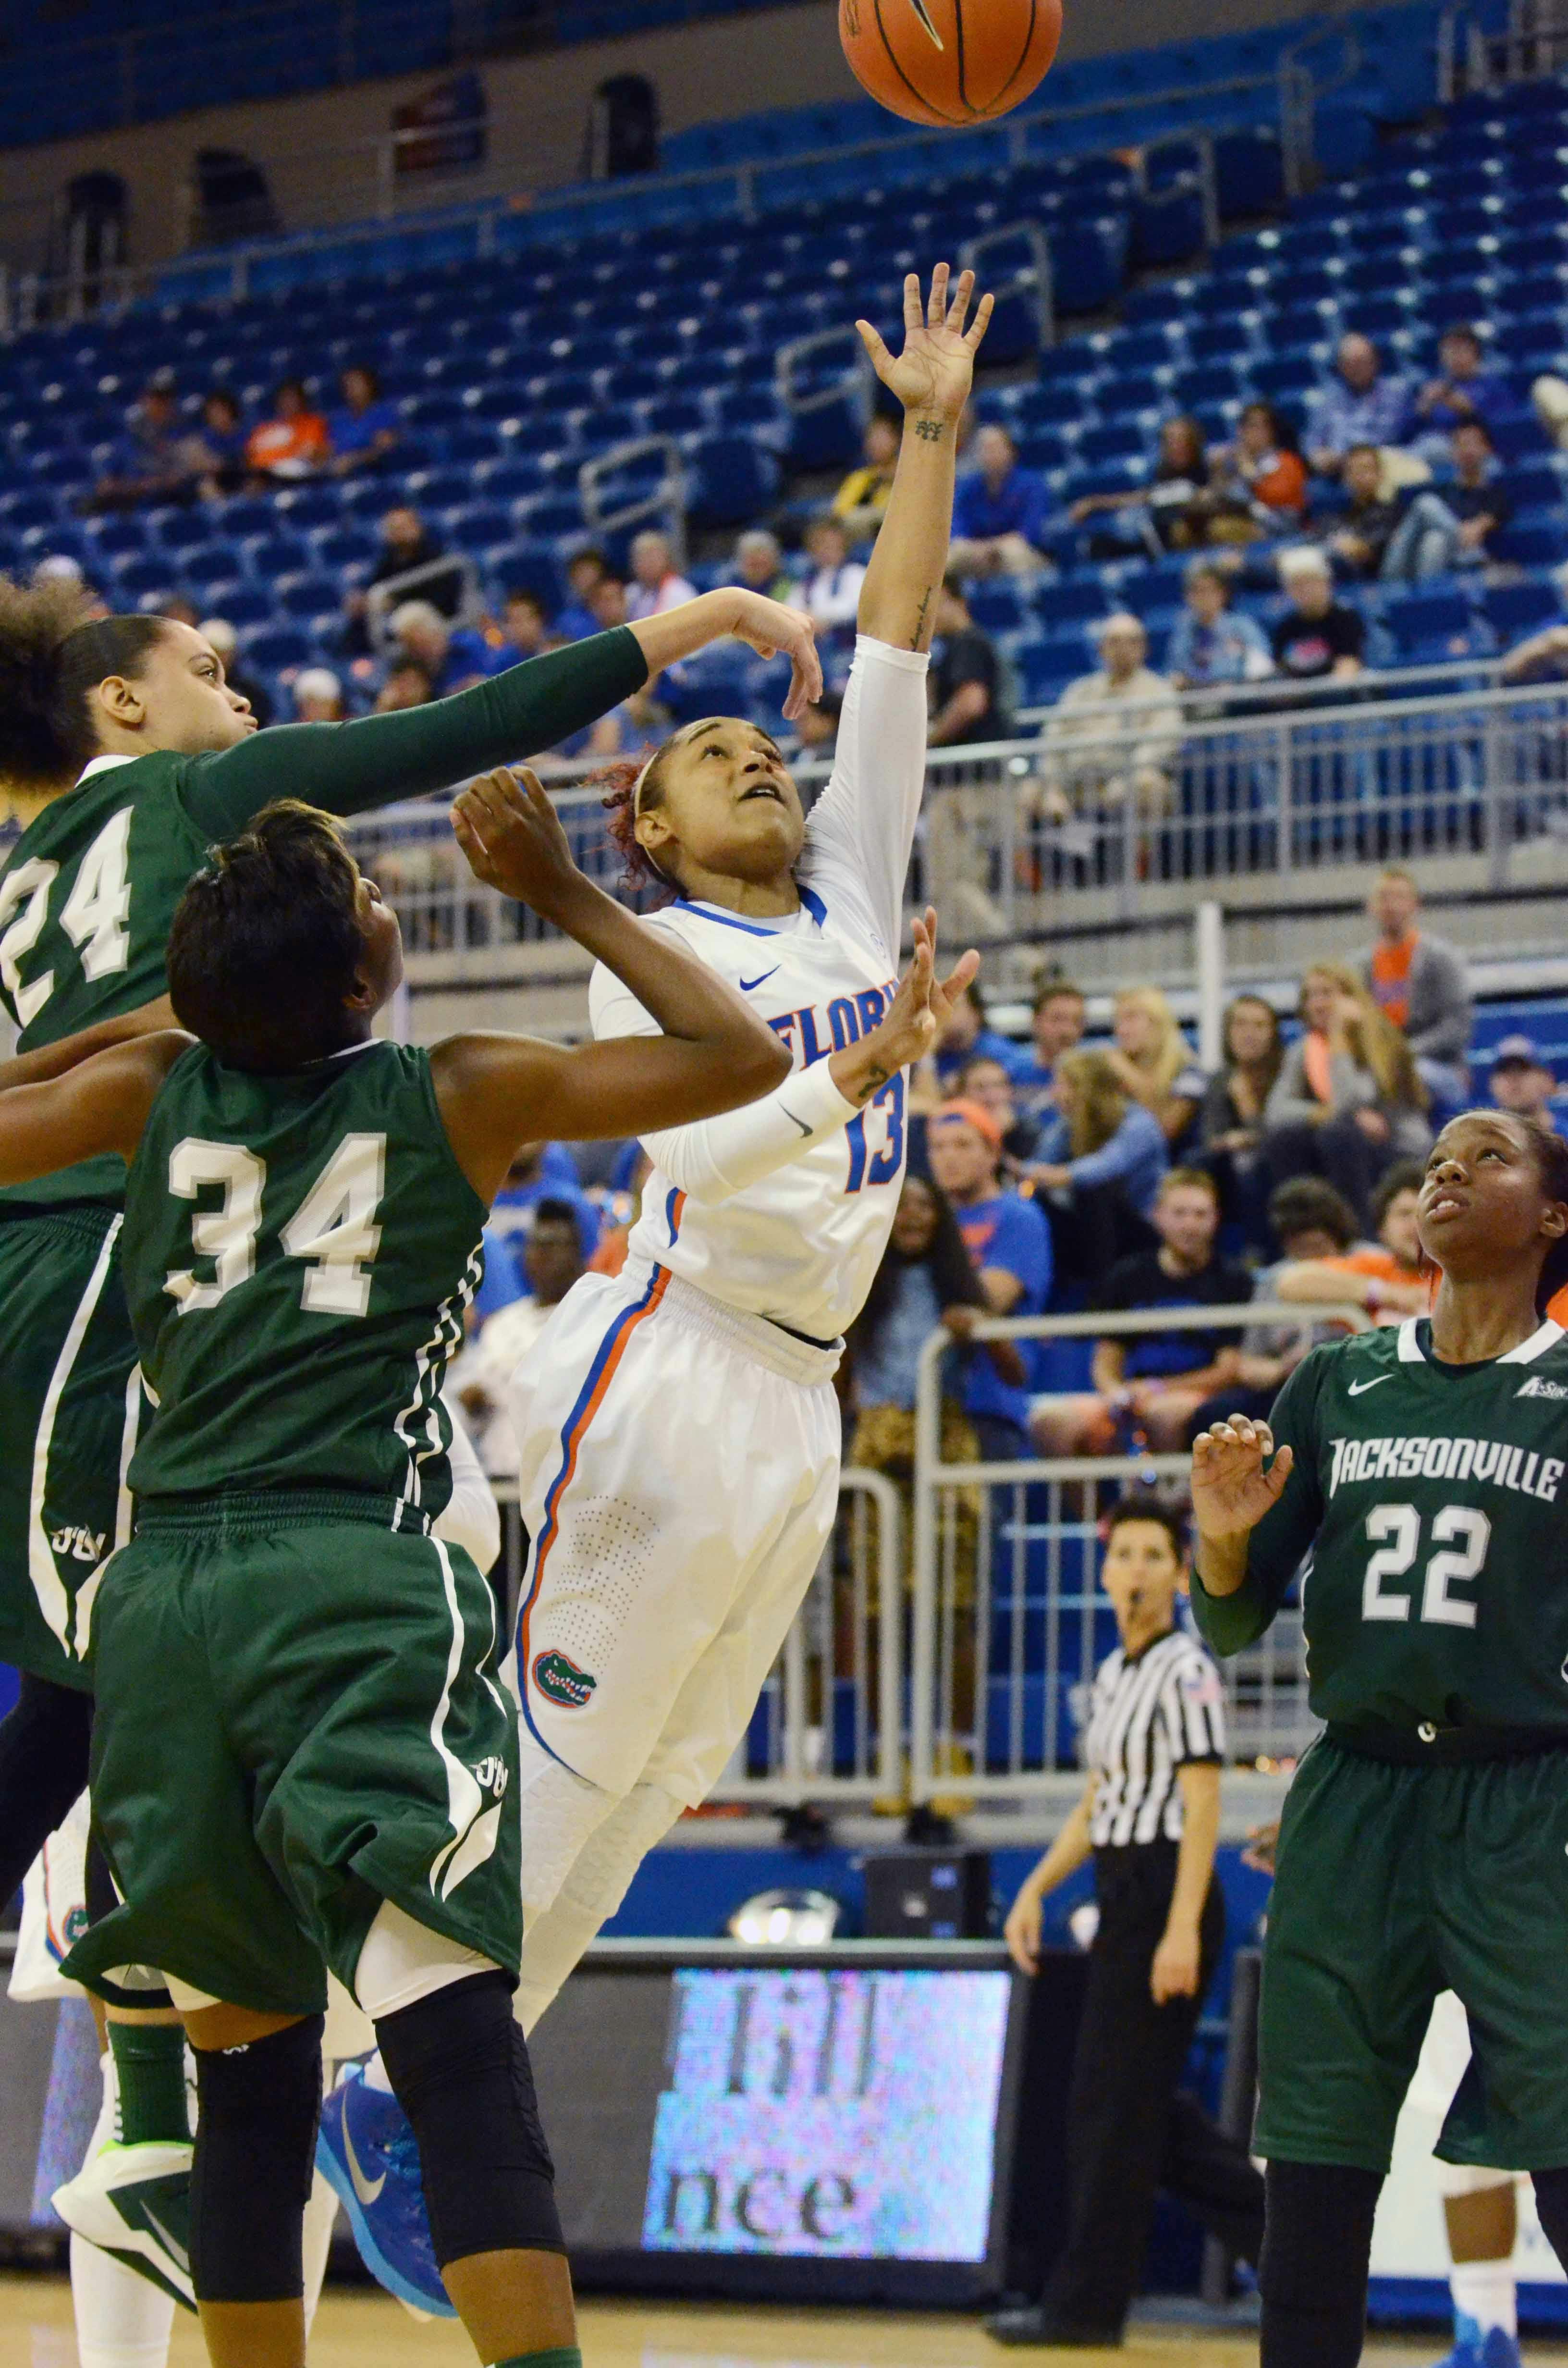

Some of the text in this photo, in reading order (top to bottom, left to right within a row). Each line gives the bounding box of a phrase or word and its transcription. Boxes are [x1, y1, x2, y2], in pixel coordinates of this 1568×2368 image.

[0, 805, 135, 1030] 24
[844, 1070, 905, 1194] 13
[162, 1132, 387, 1317] 34
[1328, 1437, 1566, 1502] JACKSONVILLE
[1361, 1503, 1492, 1629] 22
